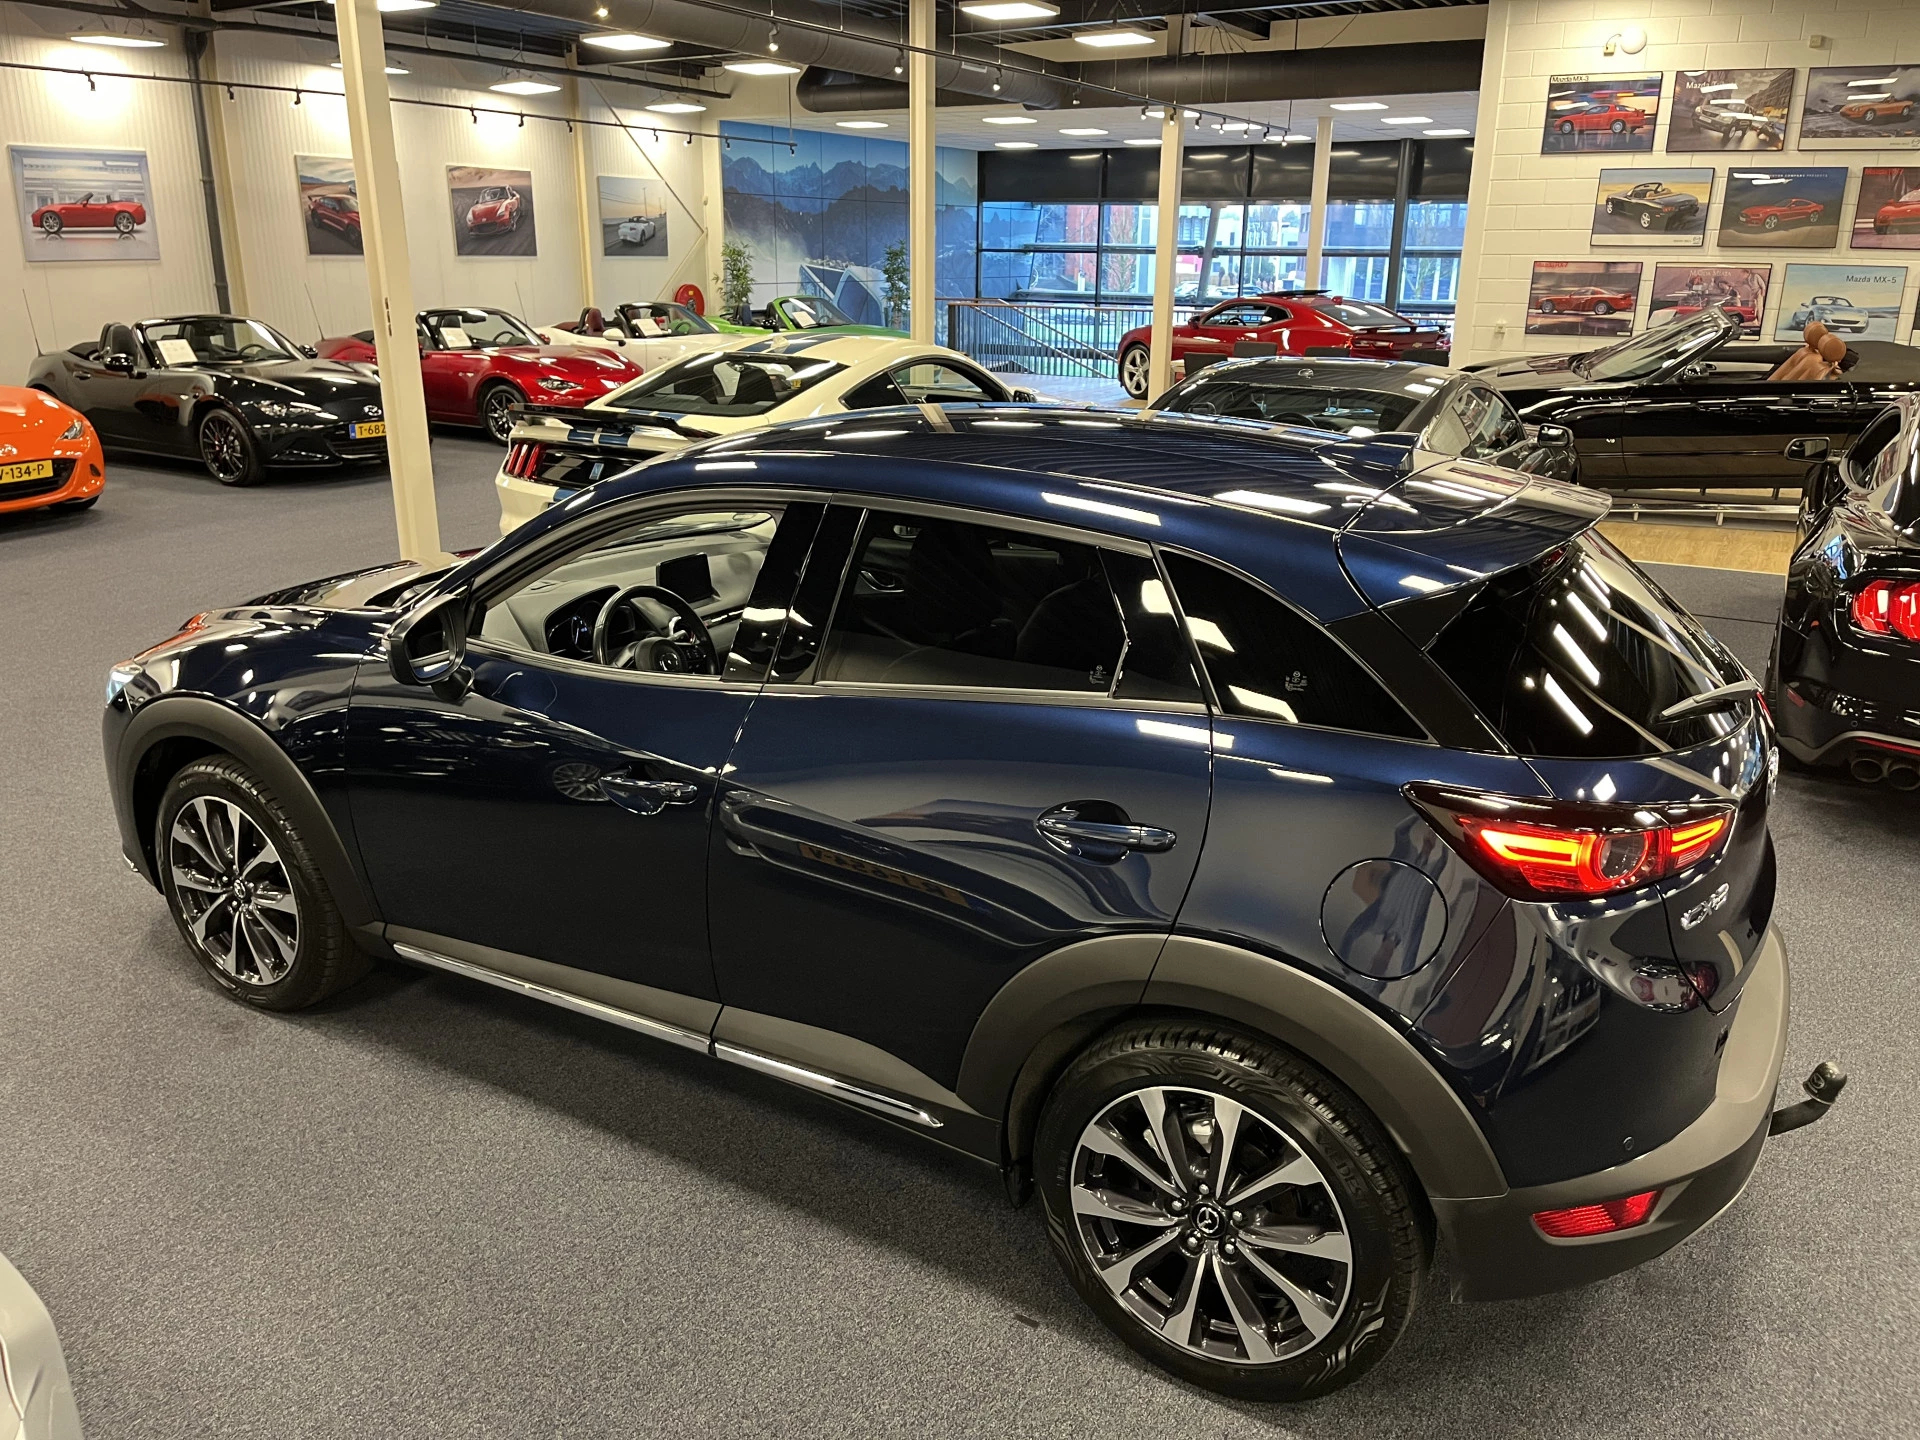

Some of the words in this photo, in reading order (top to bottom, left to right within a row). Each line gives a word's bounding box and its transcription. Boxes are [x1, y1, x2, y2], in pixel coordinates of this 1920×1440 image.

[1846, 275, 1871, 283] Mazda
[1873, 276, 1897, 284] MX-5
[358, 423, 386, 436] T-682
